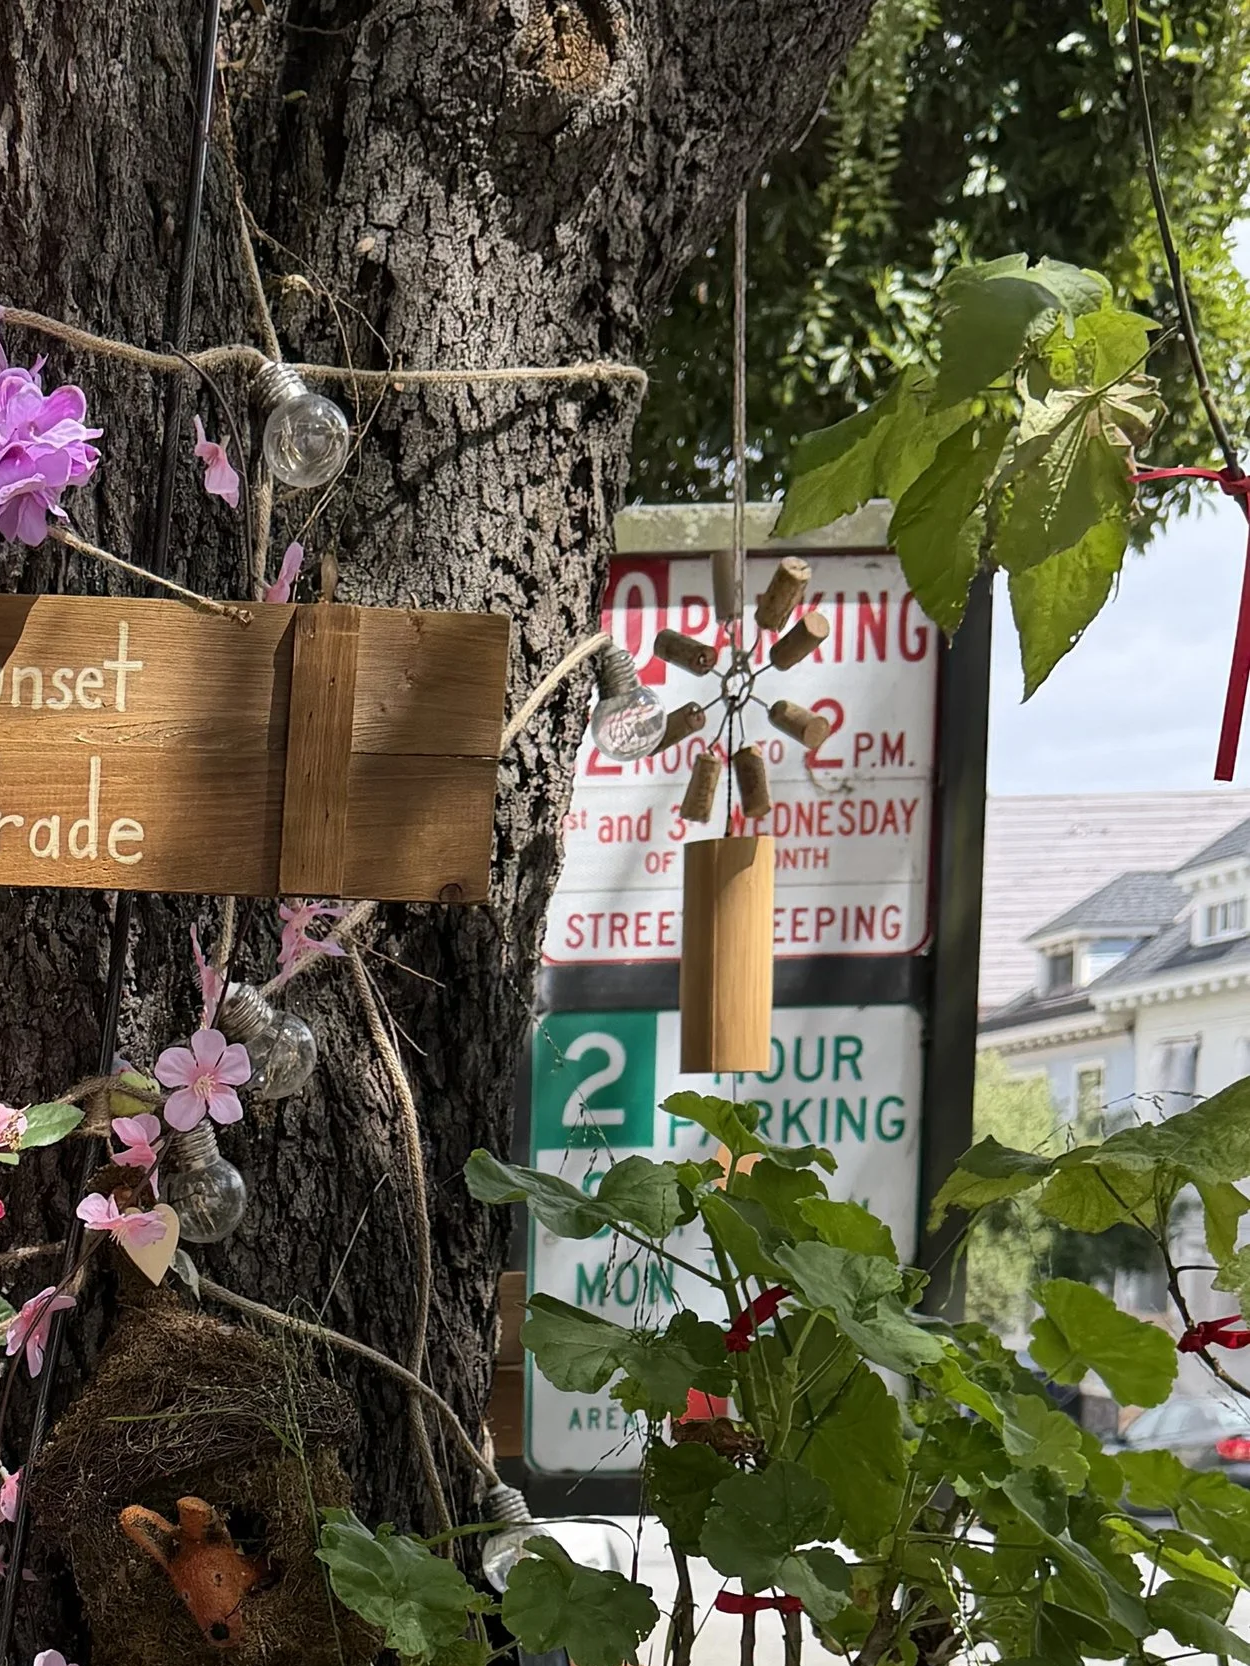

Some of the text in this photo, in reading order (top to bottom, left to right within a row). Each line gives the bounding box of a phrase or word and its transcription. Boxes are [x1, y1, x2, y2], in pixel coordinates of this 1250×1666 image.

[854, 731, 917, 768] P.M.
[598, 807, 653, 844] and
[645, 851, 676, 874] OF
[565, 910, 678, 950] STREE
[561, 1031, 627, 1127] 2
[713, 1034, 864, 1085] OUR
[667, 1095, 907, 1148] PRKING
